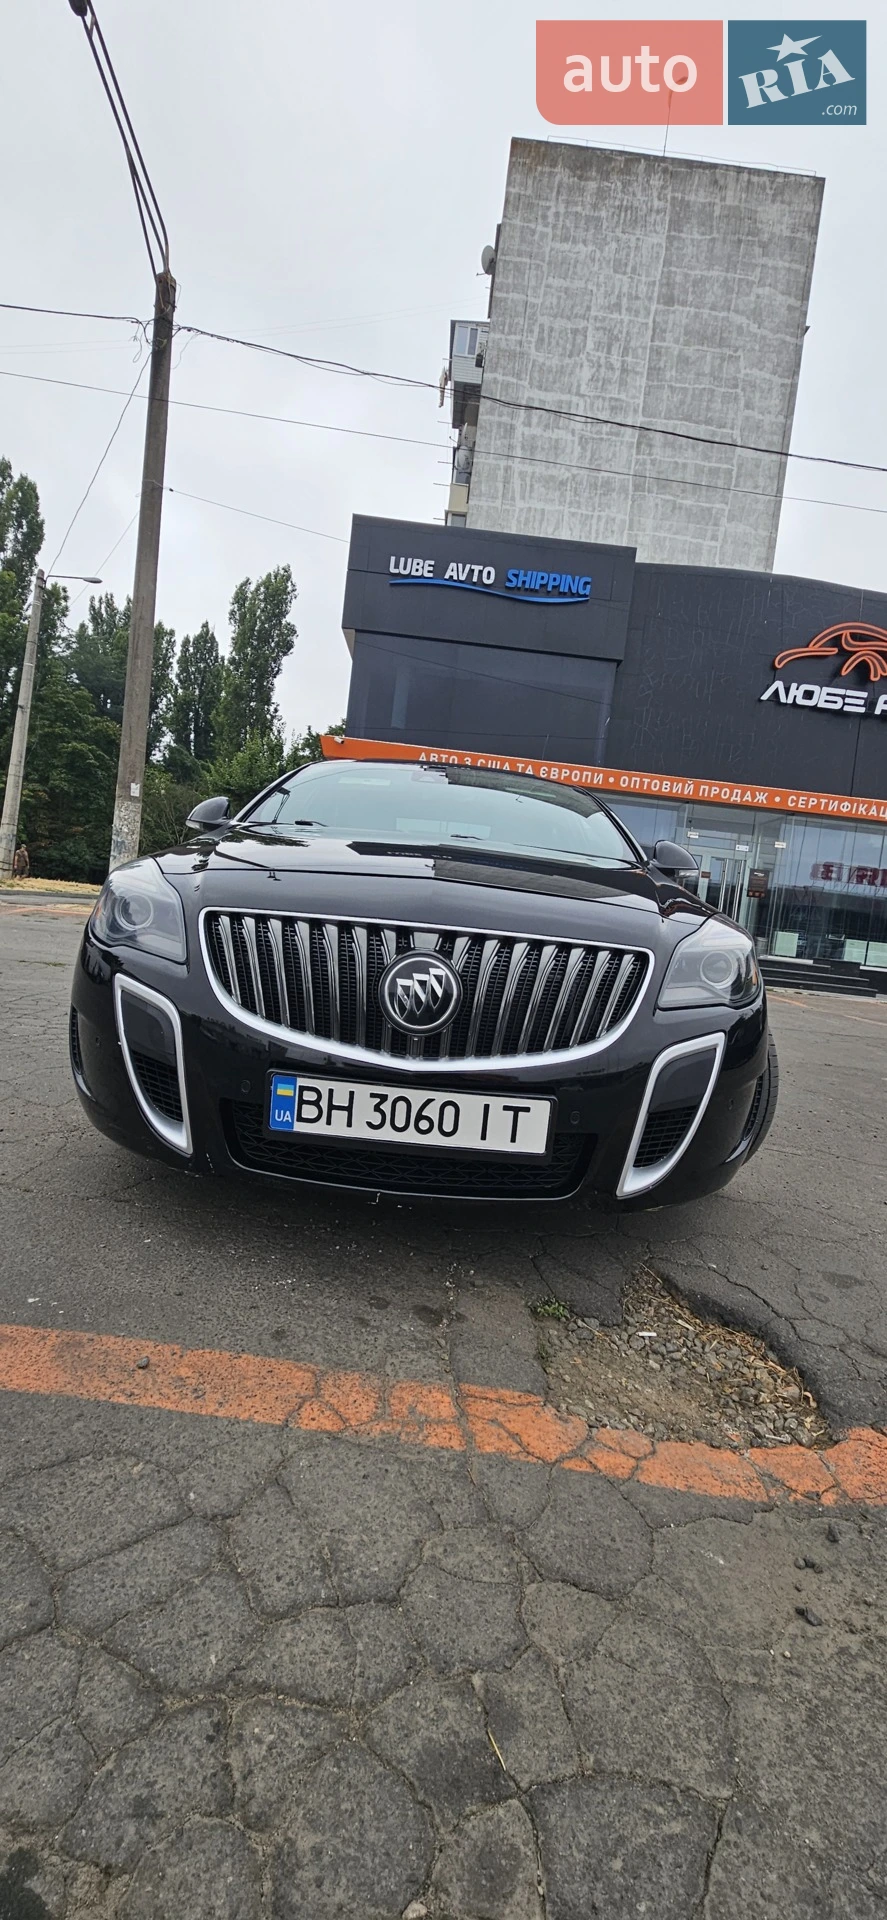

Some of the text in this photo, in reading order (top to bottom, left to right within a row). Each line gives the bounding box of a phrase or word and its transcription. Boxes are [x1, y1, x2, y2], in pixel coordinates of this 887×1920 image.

[389, 556, 592, 595] LUBE AVTO SHIPPING
[760, 680, 868, 713] ЛЮБЕ
[516, 763, 534, 775] ТА
[539, 766, 603, 785] ЄВРОПИ
[619, 775, 694, 796] ОПТОВИЙ
[698, 785, 768, 804] ПРОДАЖ
[275, 1109, 292, 1123] UA
[296, 1085, 531, 1144] BH 3060 IT
